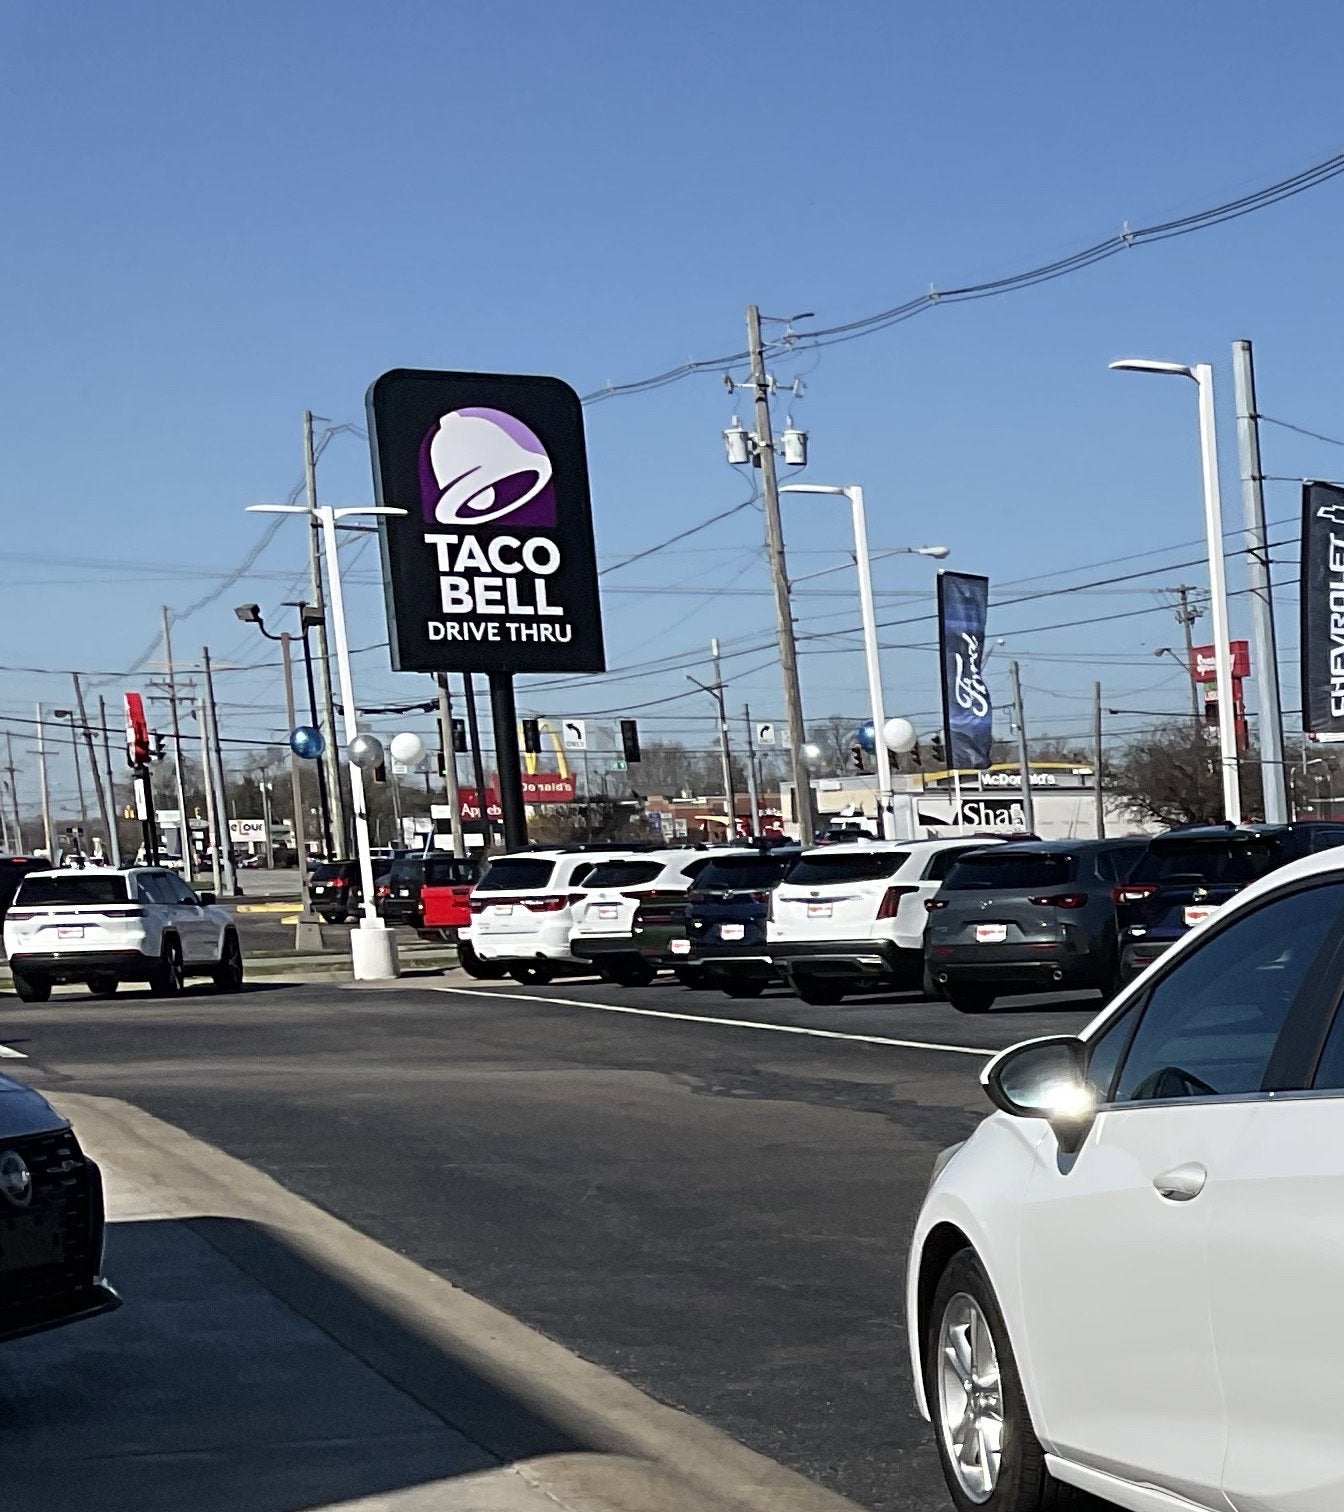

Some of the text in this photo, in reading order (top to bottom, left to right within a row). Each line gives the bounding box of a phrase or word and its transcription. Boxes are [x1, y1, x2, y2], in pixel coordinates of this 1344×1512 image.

[424, 533, 561, 575] TACO
[440, 576, 564, 616] BELL
[428, 621, 572, 643] DRIVE THRU
[955, 632, 988, 717] Ford
